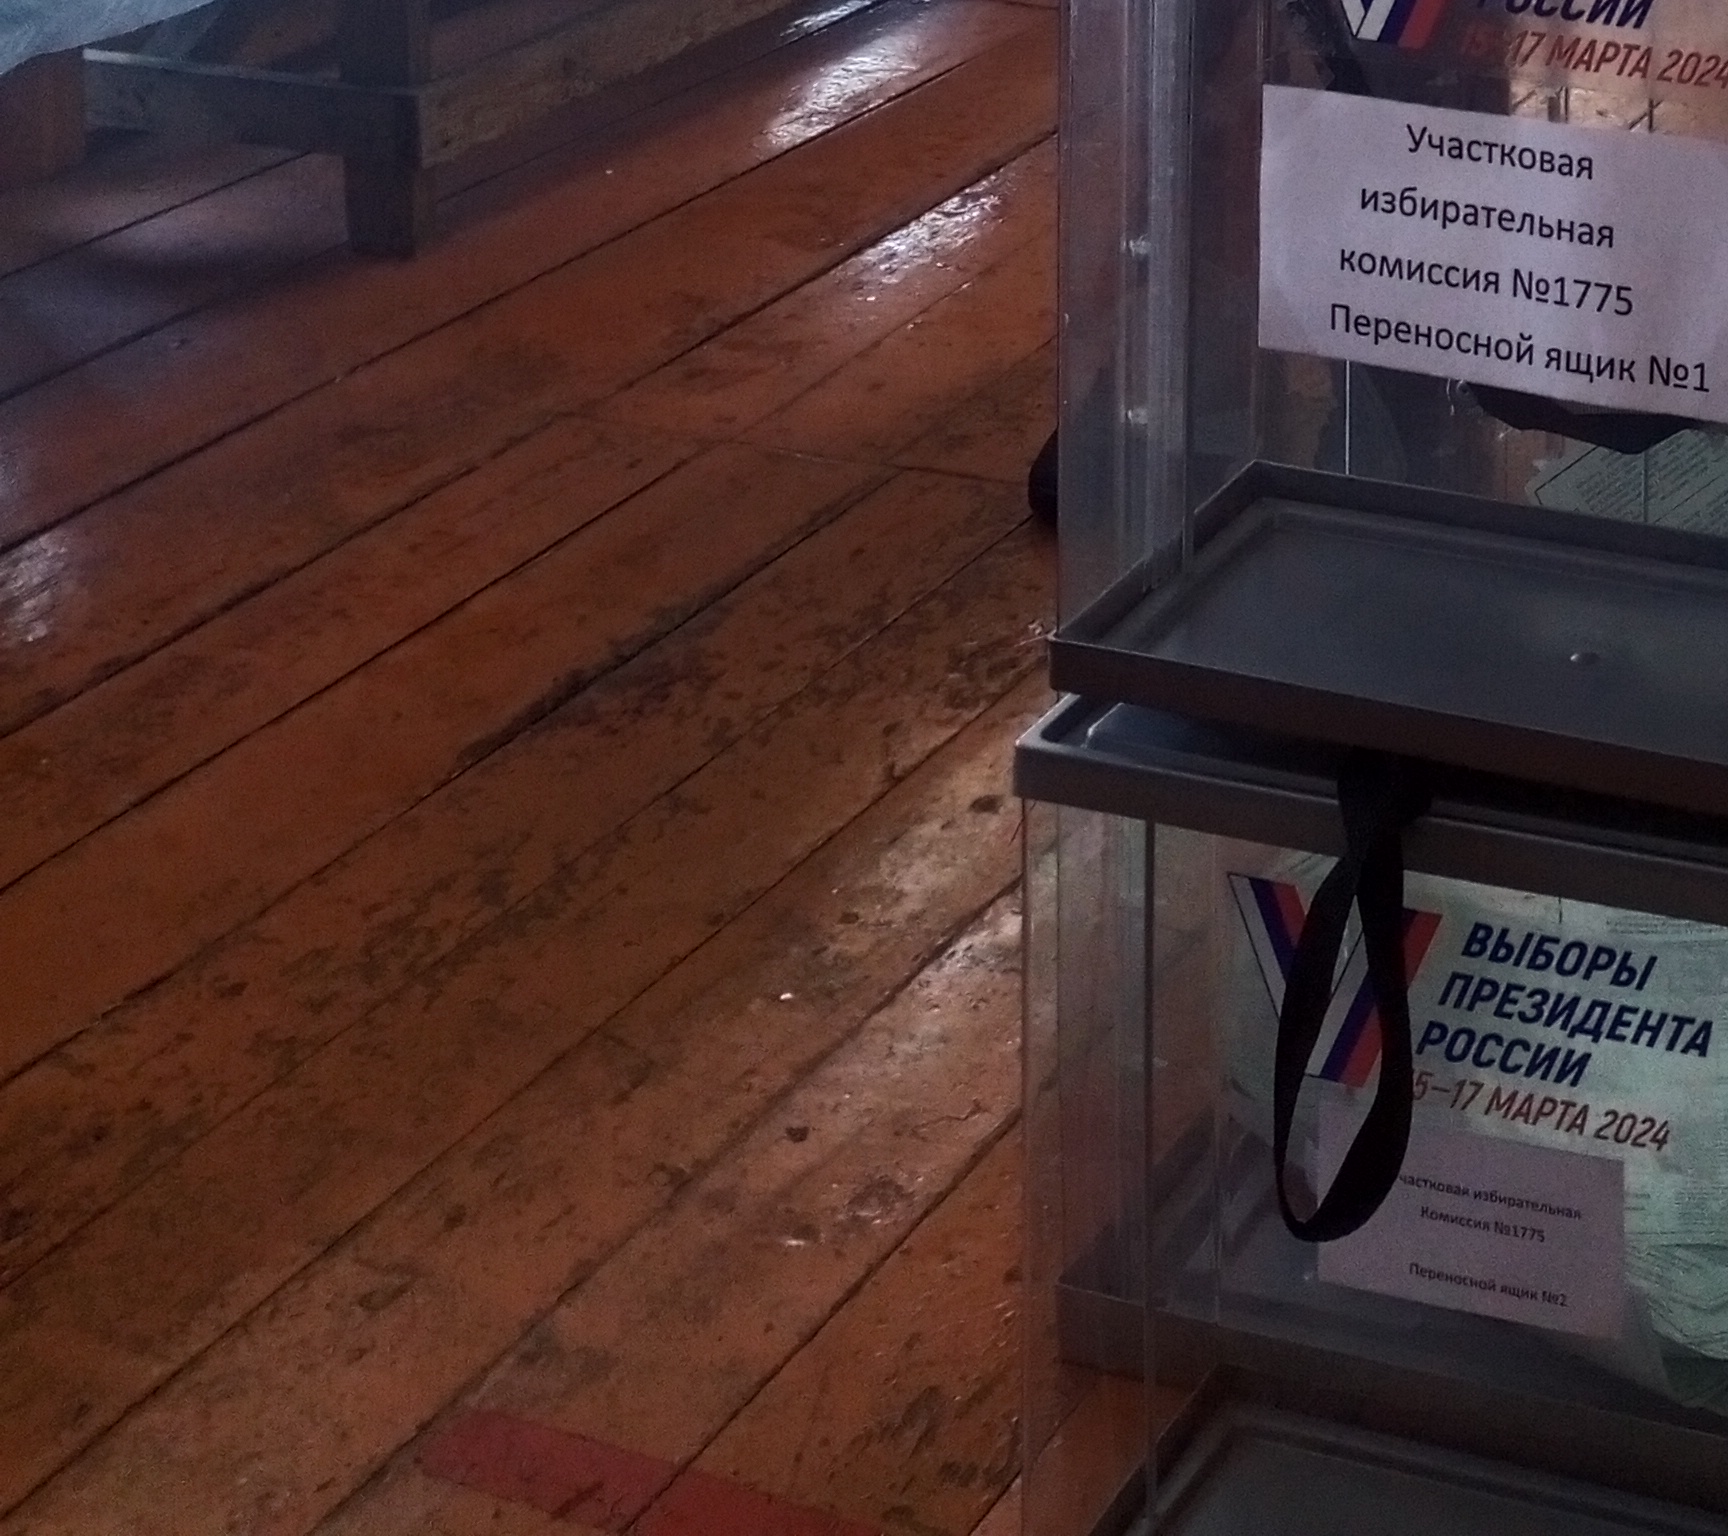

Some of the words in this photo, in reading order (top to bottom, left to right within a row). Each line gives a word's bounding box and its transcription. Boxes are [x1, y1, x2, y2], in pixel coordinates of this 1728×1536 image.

[1544, 34, 1650, 81] МАРТА
[1406, 123, 1594, 181] Участковая
[1359, 185, 1615, 250] избирательная
[1339, 246, 1500, 296] комиссия
[1512, 268, 1634, 317] №1775
[1329, 303, 1534, 367] Переносной
[1544, 345, 1636, 387] ящик
[1648, 355, 1711, 393] №1
[1461, 921, 1659, 992] ВЫБОРЫ
[1438, 971, 1718, 1059] ПРЕЗИДЕНТА
[1416, 1020, 1592, 1089] РОССИИ
[1411, 1070, 1485, 1111] 5–17
[1485, 1085, 1589, 1139] МАРТА
[1594, 1109, 1671, 1152] 2024
[1399, 1174, 1470, 1198] частковая
[1473, 1189, 1582, 1221] избирательная
[1420, 1205, 1491, 1232] Комиссия
[1494, 1221, 1546, 1243] №1775
[1408, 1262, 1497, 1293] Переносной
[1500, 1283, 1538, 1302] ящик
[1541, 1290, 1569, 1308] №2
